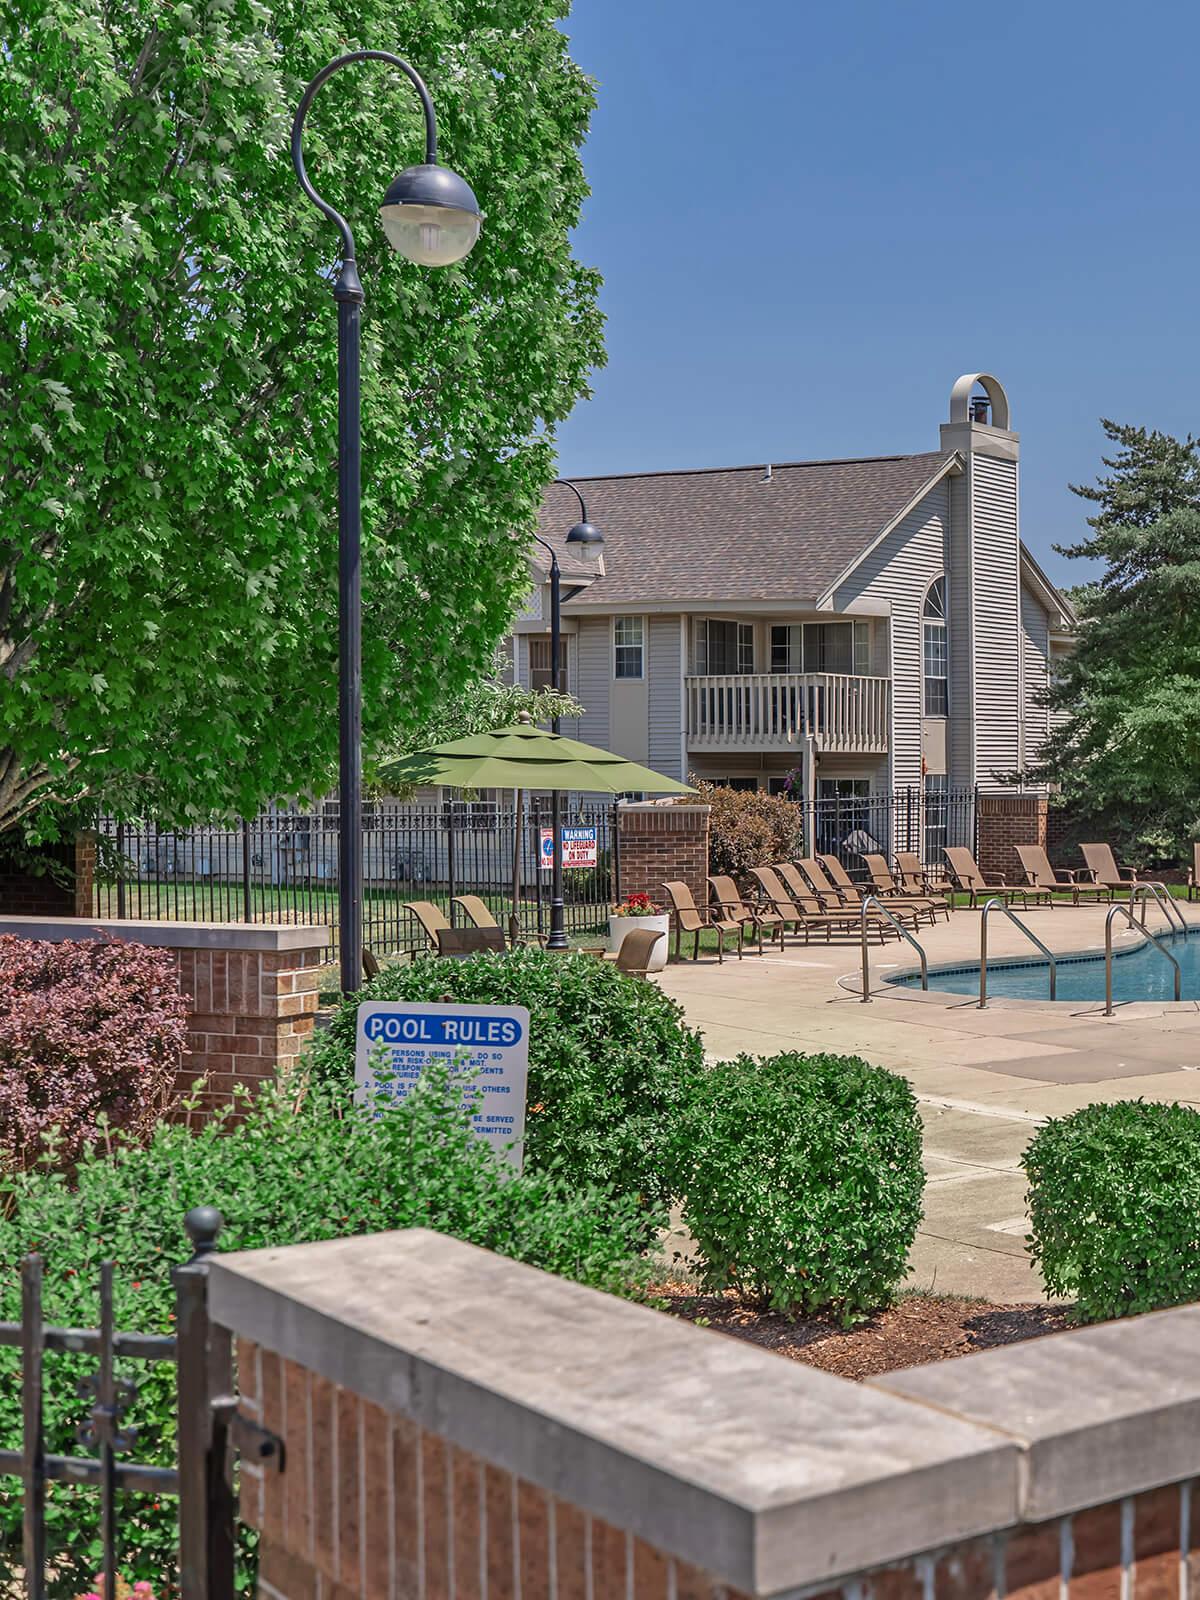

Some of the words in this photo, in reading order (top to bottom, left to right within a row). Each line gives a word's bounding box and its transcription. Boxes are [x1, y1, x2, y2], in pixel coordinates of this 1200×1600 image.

[564, 829, 594, 840] WARNING
[562, 841, 569, 850] NO
[570, 840, 595, 850] LIFEGUARD
[569, 851, 575, 860] ON
[577, 851, 589, 860] DUTY
[370, 1017, 432, 1040] POOL
[444, 1020, 516, 1042] RULES
[392, 1049, 425, 1057] PERSONS
[429, 1050, 451, 1058] USING
[477, 1052, 489, 1060] DO
[374, 1081, 394, 1090] POOL
[397, 1082, 405, 1090] IS
[481, 1085, 511, 1094] OTHERS
[473, 1115, 483, 1123] BE
[486, 1115, 515, 1124] SERVED
